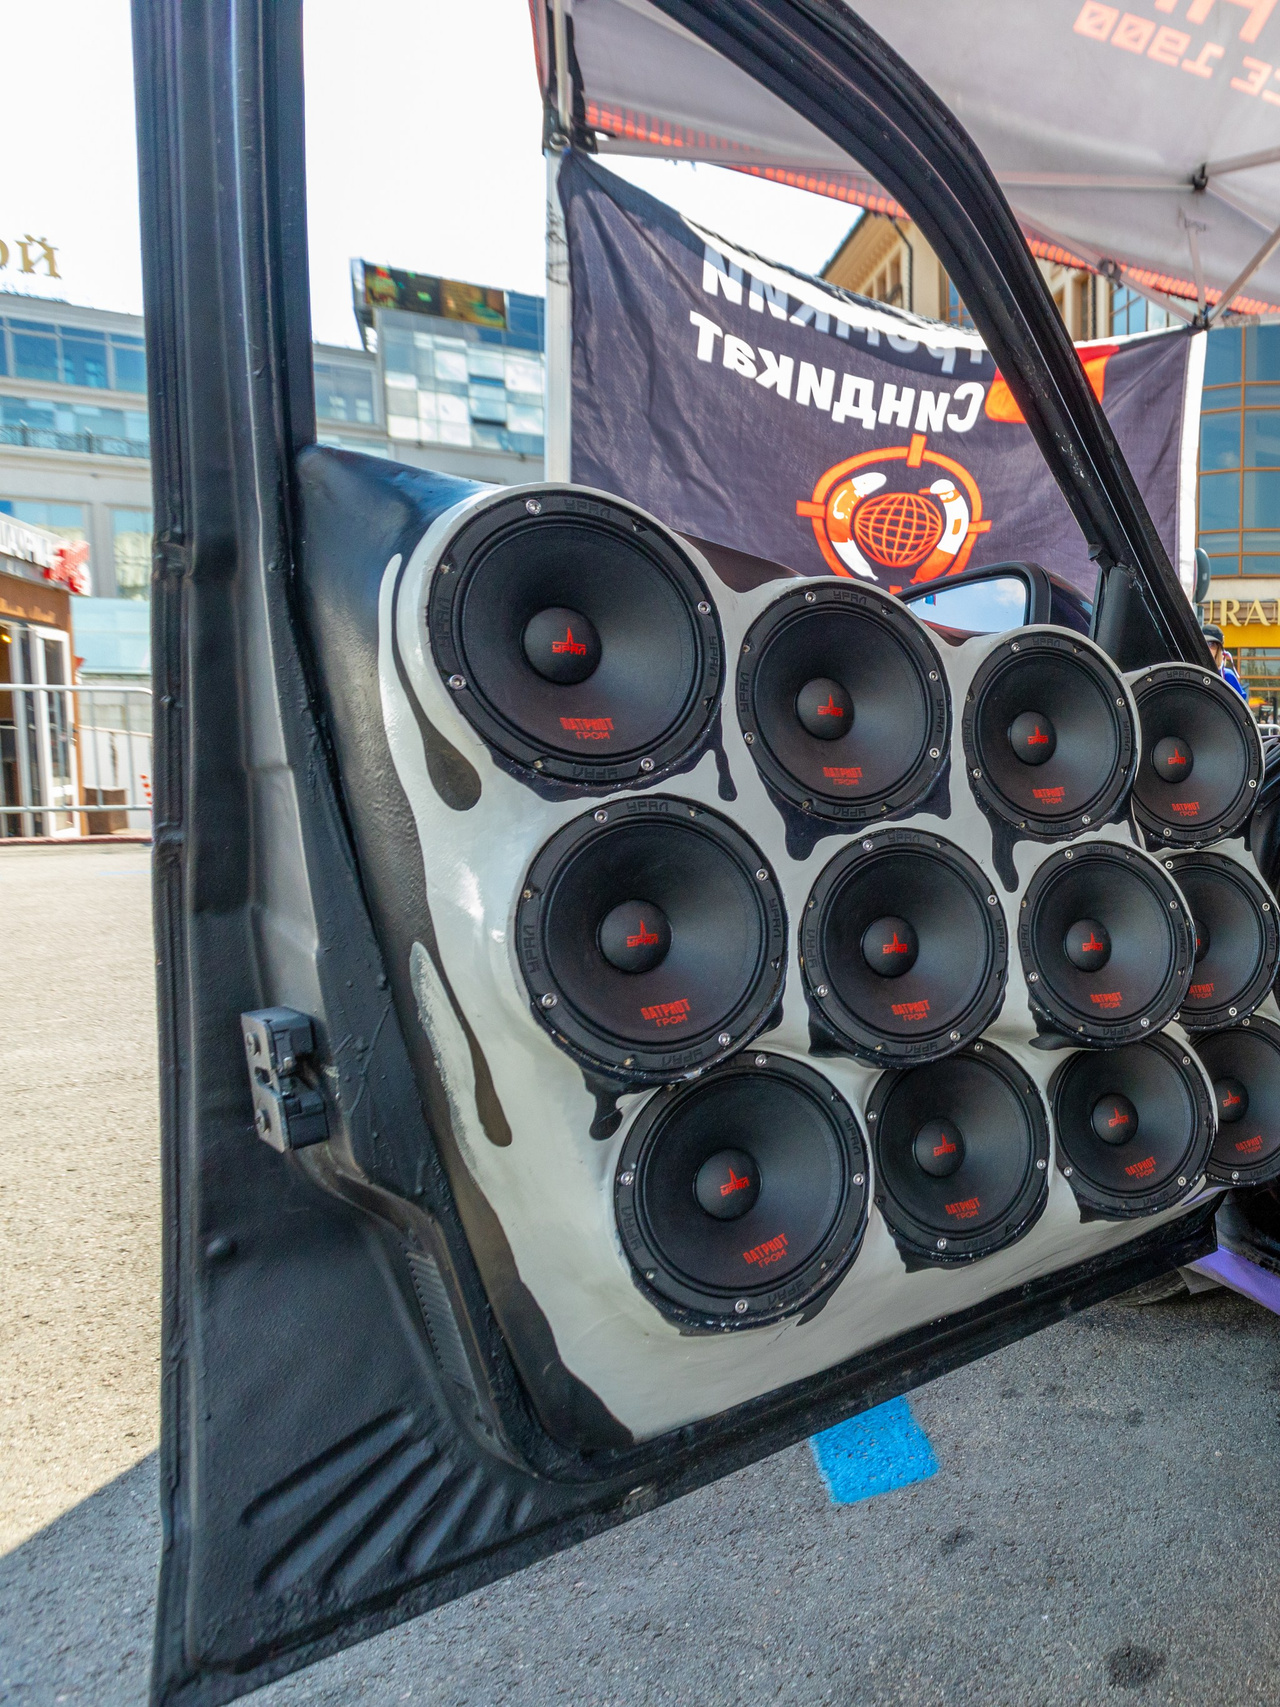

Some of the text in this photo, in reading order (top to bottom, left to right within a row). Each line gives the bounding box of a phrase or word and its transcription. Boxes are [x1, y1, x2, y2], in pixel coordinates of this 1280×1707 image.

[833, 591, 867, 605] УРАЛ
[560, 718, 614, 730] ПАТРИОТ
[576, 730, 610, 739] ГРОМ
[627, 801, 669, 812] УРАЛ
[1172, 801, 1200, 811] ПАТРИОТ
[640, 998, 691, 1019] ПАТРИОТ
[891, 999, 930, 1015] ПАТРИОТ
[656, 1014, 688, 1027] ГРОМ
[902, 1012, 928, 1021] ГРОМ
[1236, 1135, 1264, 1151] ПАТРИОТ
[1125, 1156, 1157, 1175] ПАТРИОТ
[945, 1197, 980, 1215] ПАТРИОТ
[956, 1211, 979, 1220] ГРОМ
[743, 1233, 789, 1264] ПАТРИОТ
[757, 1250, 788, 1269] ГРОМ
